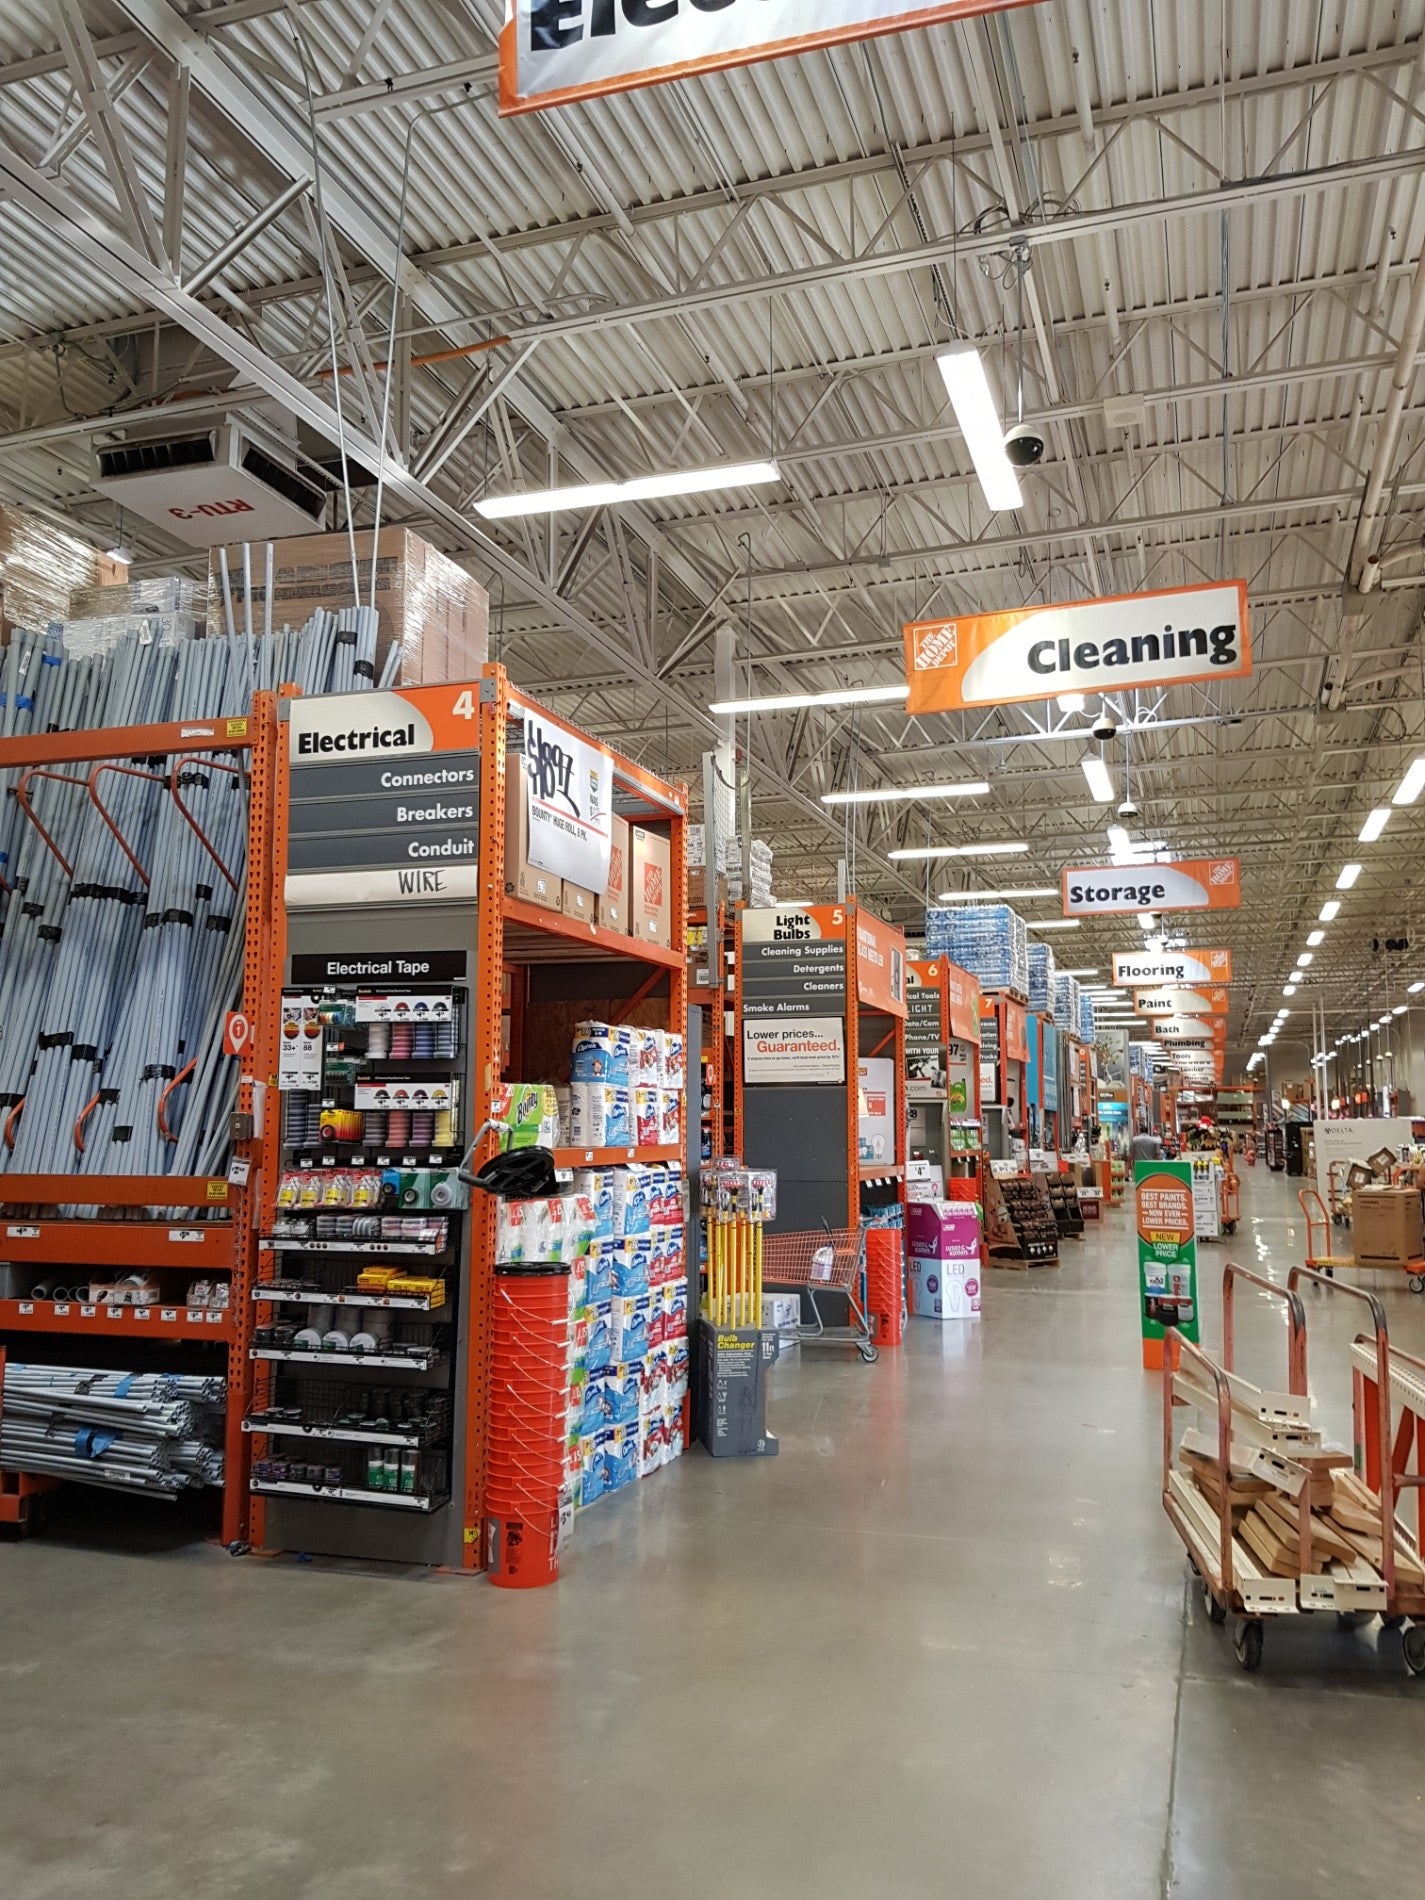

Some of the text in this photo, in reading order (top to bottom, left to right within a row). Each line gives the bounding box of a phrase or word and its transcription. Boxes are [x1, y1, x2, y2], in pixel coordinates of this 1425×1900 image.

[915, 624, 954, 669] HOME
[1027, 624, 1236, 674] Cleaning
[452, 690, 475, 720] 4
[298, 723, 415, 754] Electrical
[380, 768, 474, 788] Connectors
[397, 804, 474, 823] Breakers
[532, 805, 551, 822] BOUNTY
[408, 839, 474, 857] Conduit
[399, 869, 447, 894] WIRE
[1070, 884, 1165, 905] Storage
[776, 915, 810, 928] Light
[832, 909, 843, 925] 5
[773, 928, 811, 940] Bulbs
[761, 945, 844, 957] Cleaning Supplies
[326, 960, 430, 976] Electrical Tape
[793, 963, 844, 974] Detergents
[928, 964, 939, 977] 6
[1117, 964, 1185, 978] Flooring
[803, 981, 844, 991] Cleaners
[921, 992, 940, 1000] Tools
[743, 1002, 810, 1013] Smoke Alarms
[985, 998, 993, 1008] 7
[1138, 998, 1173, 1008] Paint
[747, 1029, 824, 1040] Lower prices...
[905, 1033, 940, 1041] Phone/TV
[757, 1039, 841, 1053] Guaranteed.
[1164, 1040, 1205, 1048] Plumbing
[1141, 1192, 1188, 1201] BEST PAINTS.
[1159, 1201, 1188, 1209] BRANDS.
[1149, 1209, 1163, 1217] NOW
[1142, 1217, 1162, 1225] LOWER
[1156, 1231, 1174, 1240] NEW
[1153, 1242, 1178, 1251] LOWER
[1155, 1250, 1177, 1258] PRICE
[910, 1261, 922, 1272] LED
[947, 1264, 965, 1275] LED
[717, 1334, 738, 1342] Bulb
[717, 1341, 755, 1350] Changer
